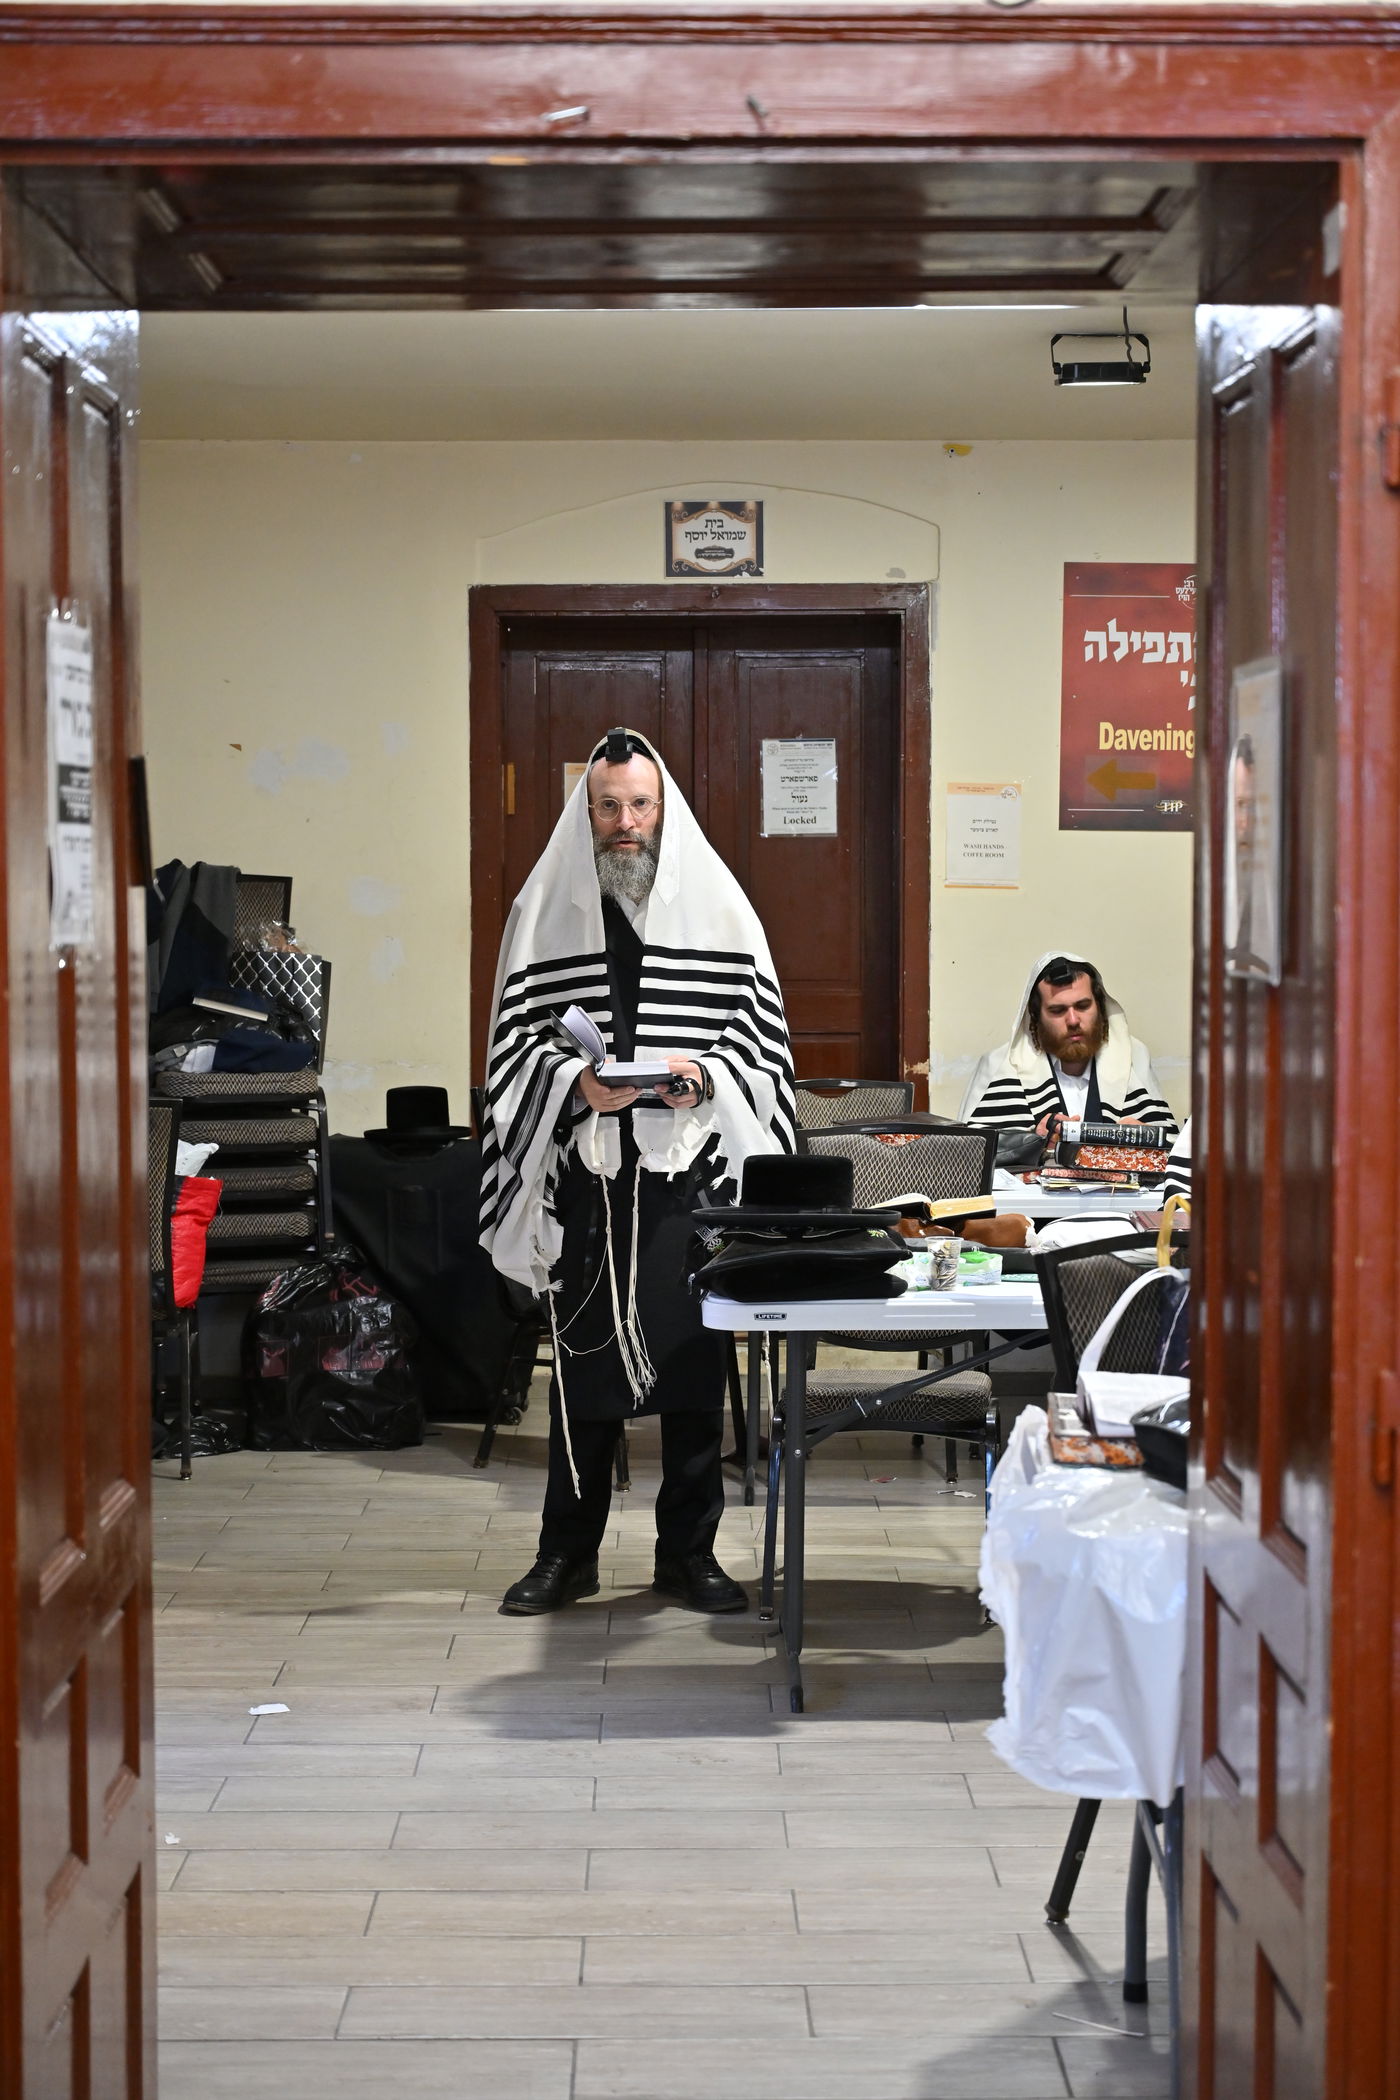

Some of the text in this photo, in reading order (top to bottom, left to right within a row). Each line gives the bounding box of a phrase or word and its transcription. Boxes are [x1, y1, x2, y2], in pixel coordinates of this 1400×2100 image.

[705, 519, 724, 528] בית
[684, 529, 746, 543] שמואל יוסף
[1084, 617, 1197, 664] תפילה
[1099, 721, 1195, 758] Davening
[783, 816, 817, 825] Locked
